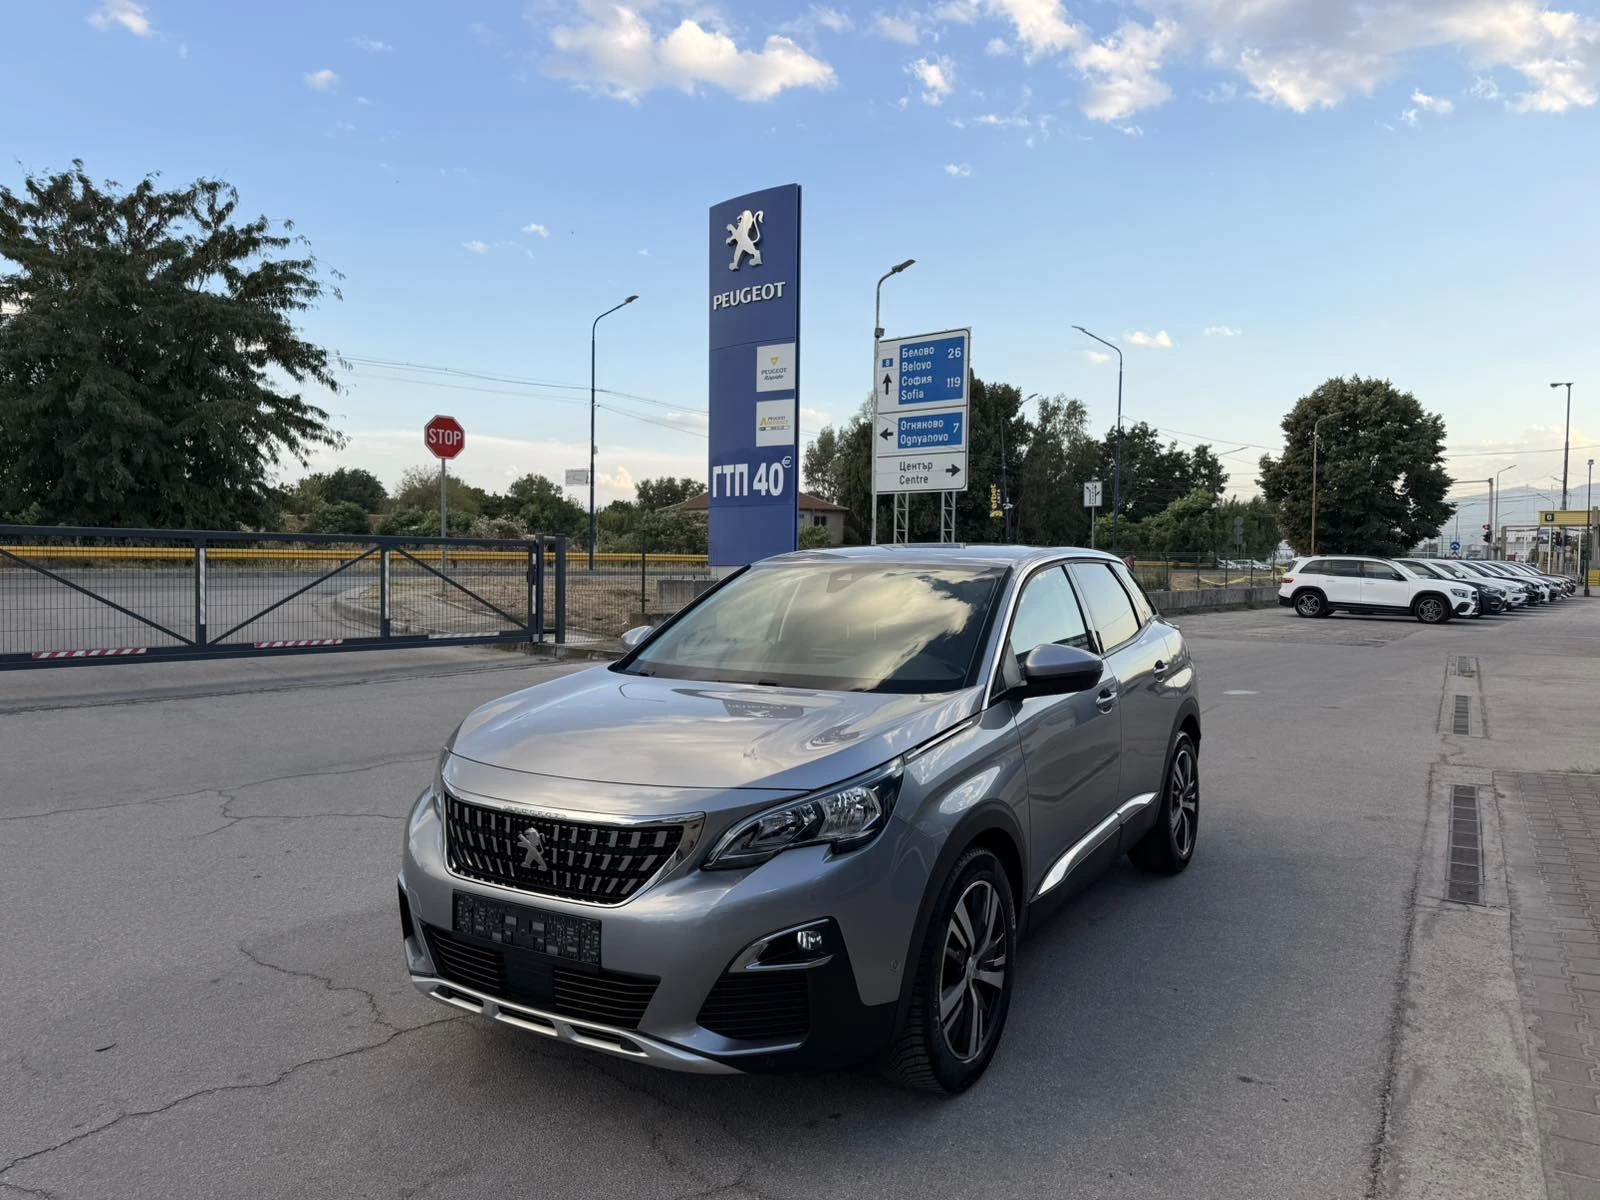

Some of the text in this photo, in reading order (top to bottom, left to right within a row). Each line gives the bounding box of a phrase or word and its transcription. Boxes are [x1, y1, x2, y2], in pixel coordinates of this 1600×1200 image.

[713, 281, 786, 310] PEUGEOT
[901, 346, 962, 359] Белово 26
[901, 360, 932, 373] Belovo
[901, 375, 961, 388] София 119
[900, 389, 924, 400] Sofia
[900, 419, 960, 433] Огняново 7
[428, 428, 462, 446] STOP
[900, 433, 949, 447] Ognyanovo
[899, 461, 933, 472] Център
[712, 463, 749, 498] ГТП
[899, 475, 929, 485] Centre
